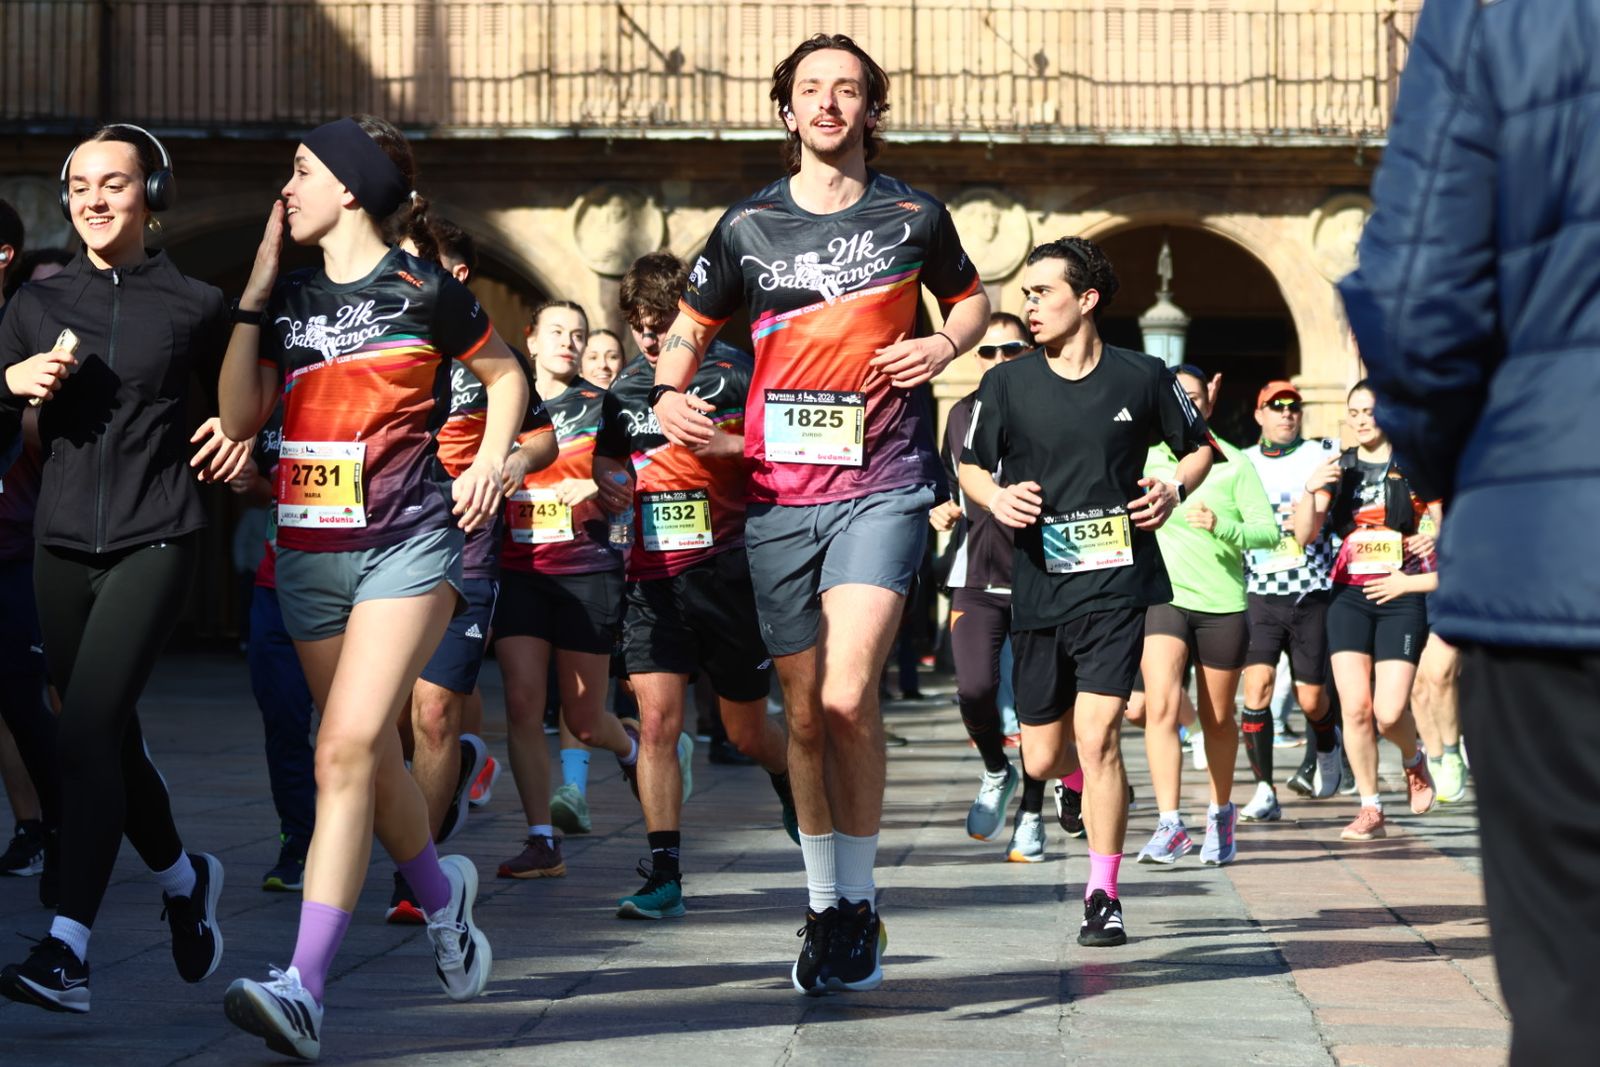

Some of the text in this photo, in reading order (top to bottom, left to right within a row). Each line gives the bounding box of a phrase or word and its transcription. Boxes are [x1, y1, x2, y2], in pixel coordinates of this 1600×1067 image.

[828, 225, 896, 265] 21k
[335, 299, 395, 329] 21k
[817, 393, 835, 402] 2026
[784, 408, 844, 429] 1825
[291, 464, 340, 487] 2731
[319, 516, 354, 524] bedunia
[518, 503, 558, 518] 2743
[653, 504, 696, 522] 1532
[1060, 521, 1114, 543] 1534
[1356, 543, 1391, 555] 2646
